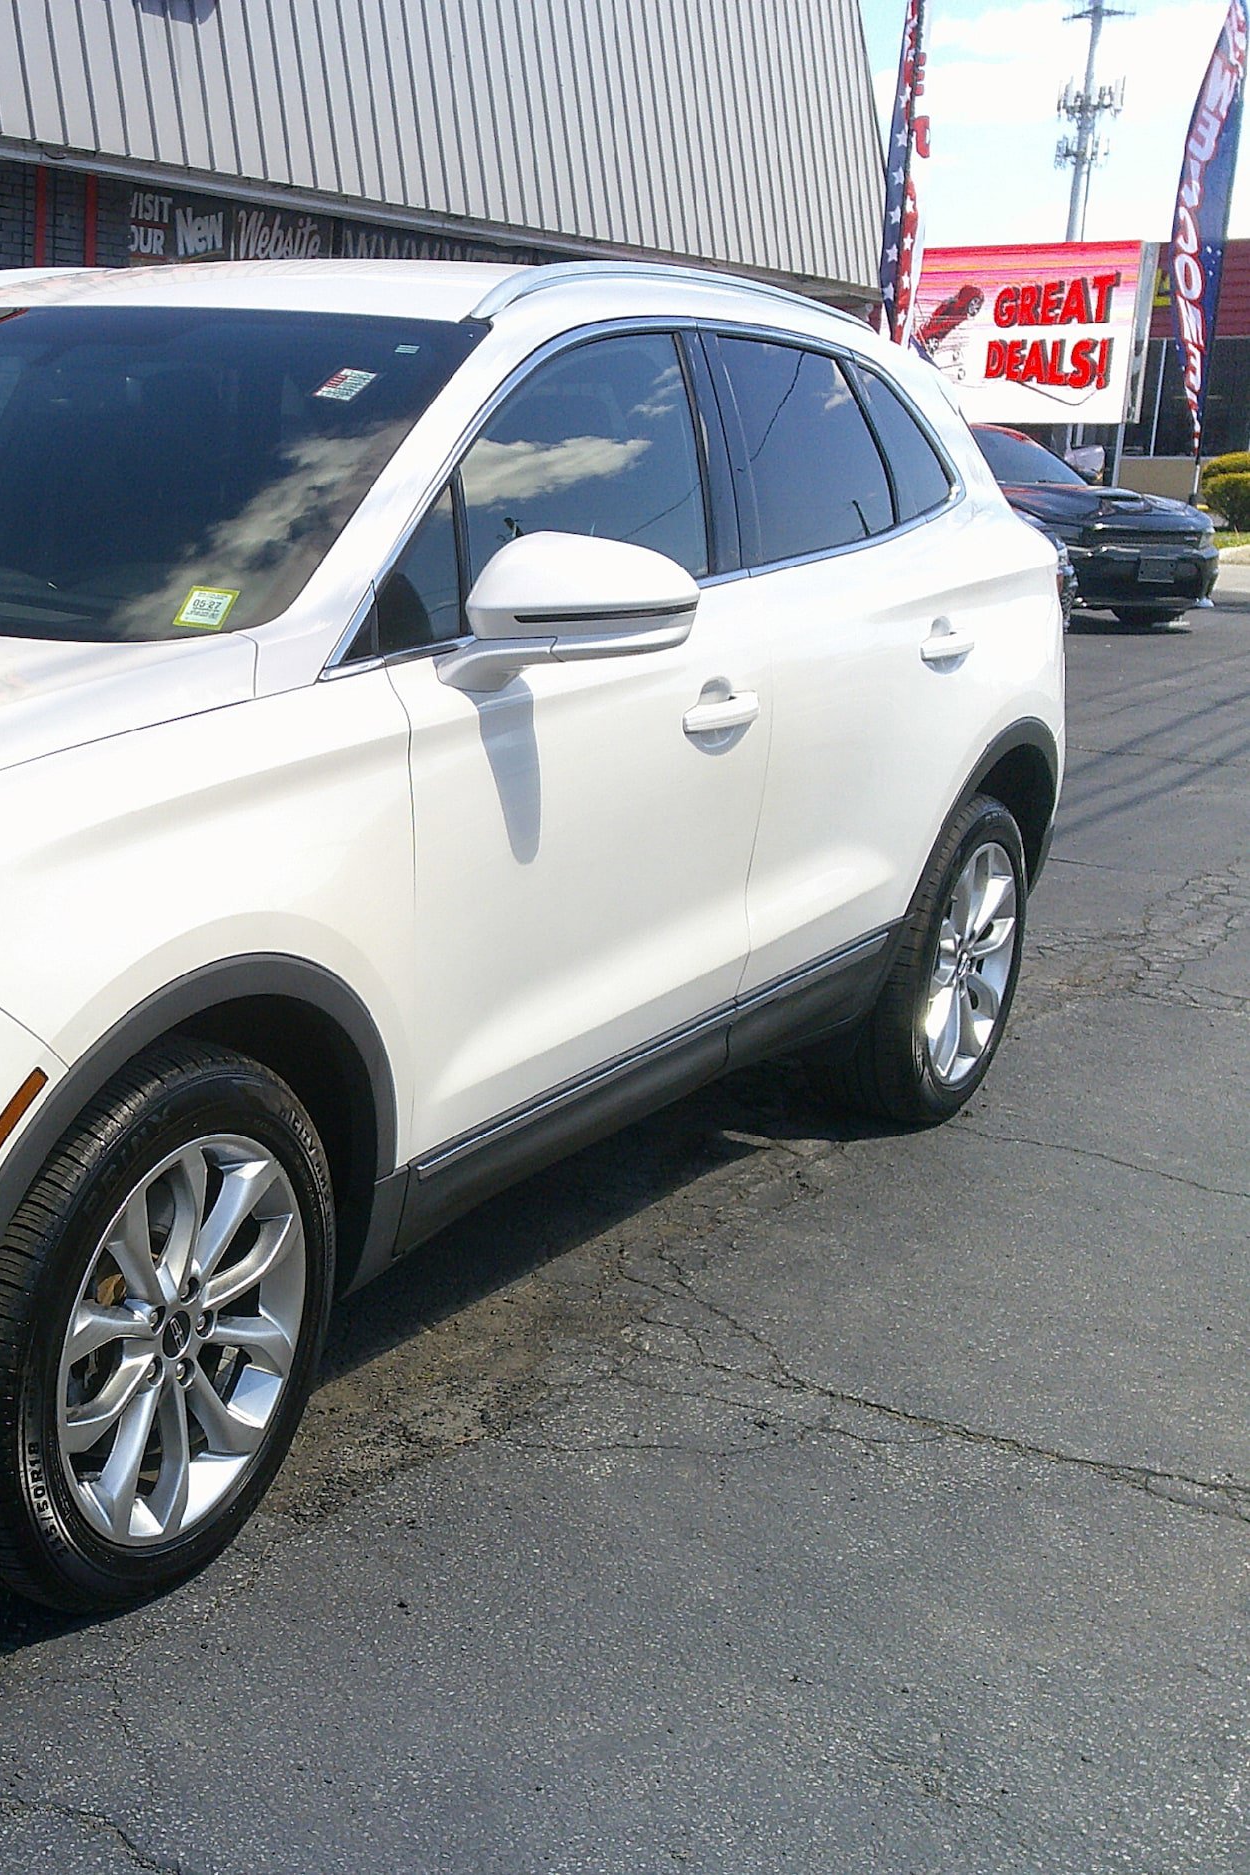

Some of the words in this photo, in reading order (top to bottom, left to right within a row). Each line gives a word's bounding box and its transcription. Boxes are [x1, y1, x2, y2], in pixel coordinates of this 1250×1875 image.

[175, 206, 224, 257] New
[238, 209, 322, 259] Website
[993, 269, 1121, 328] GREAT
[984, 337, 1115, 390] DEALS!
